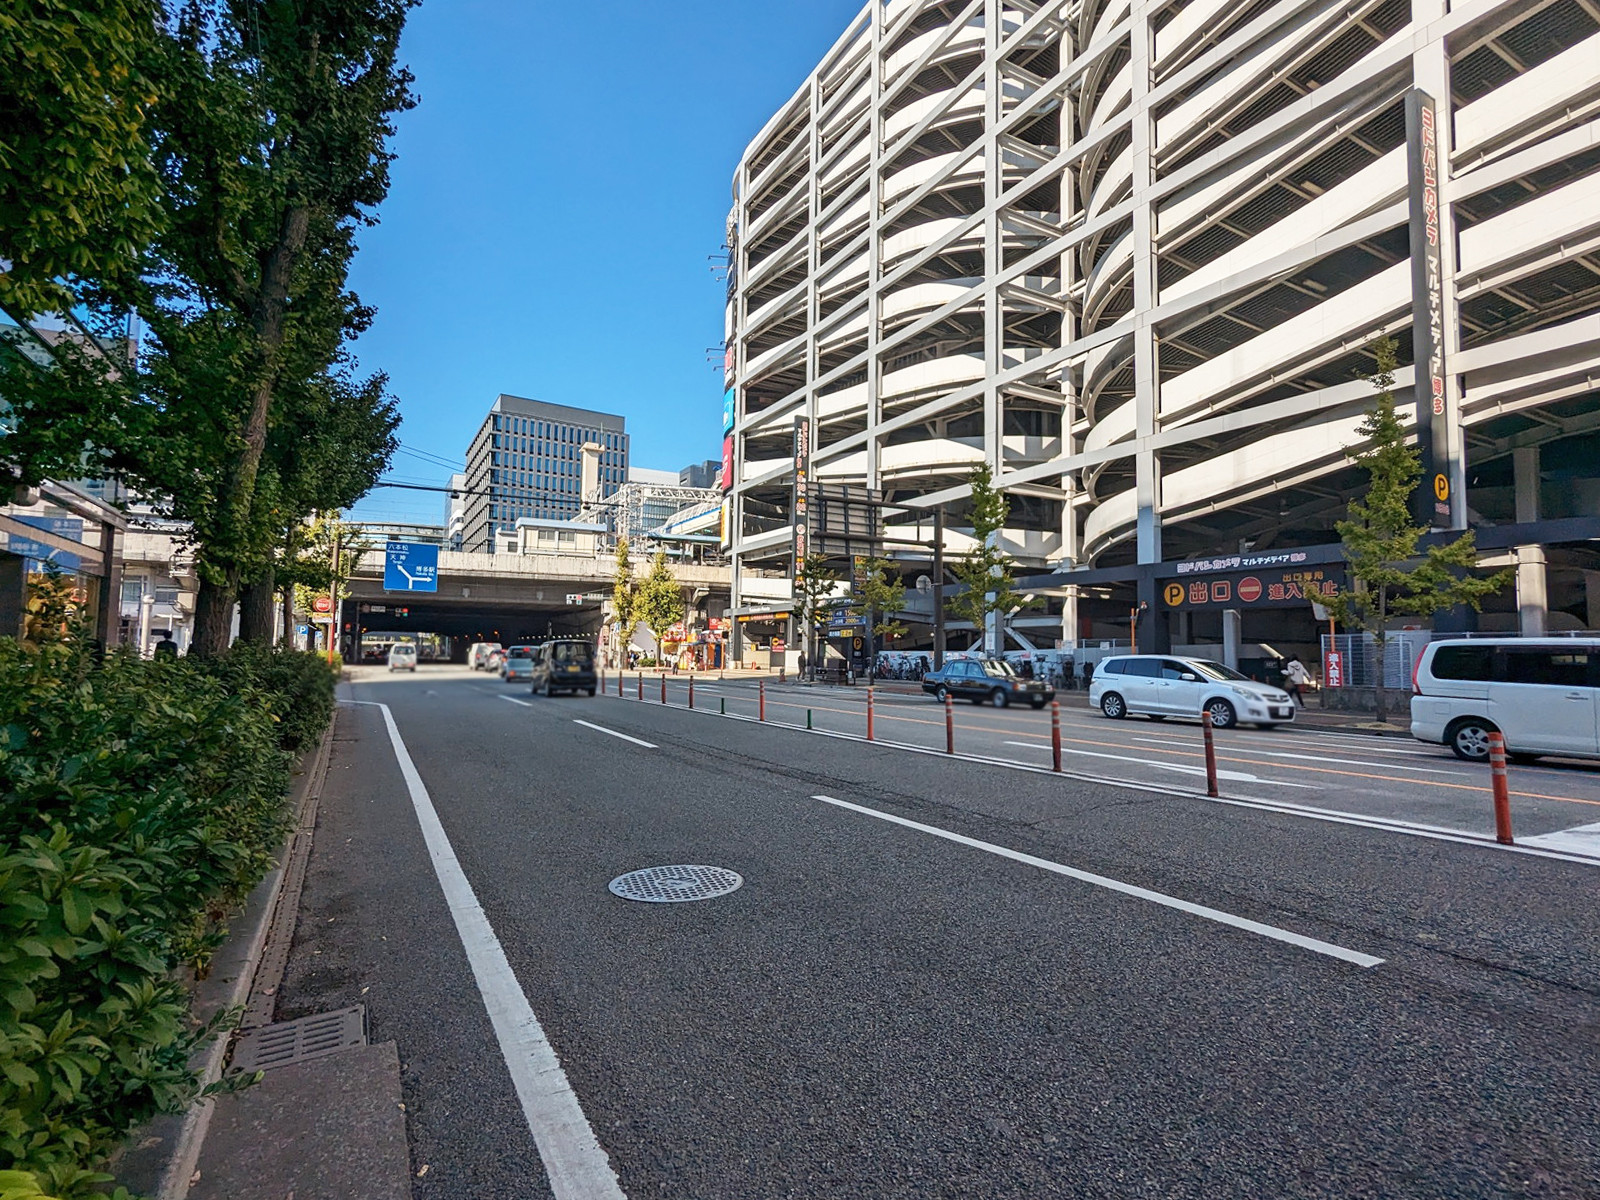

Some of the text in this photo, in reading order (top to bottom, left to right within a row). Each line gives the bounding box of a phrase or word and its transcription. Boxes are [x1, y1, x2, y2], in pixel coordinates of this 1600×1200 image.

[1422, 106, 1439, 247] ヨドバシカメラ
[1176, 557, 1241, 574] ヨドバシカメラ
[1189, 581, 1231, 604] 出口
